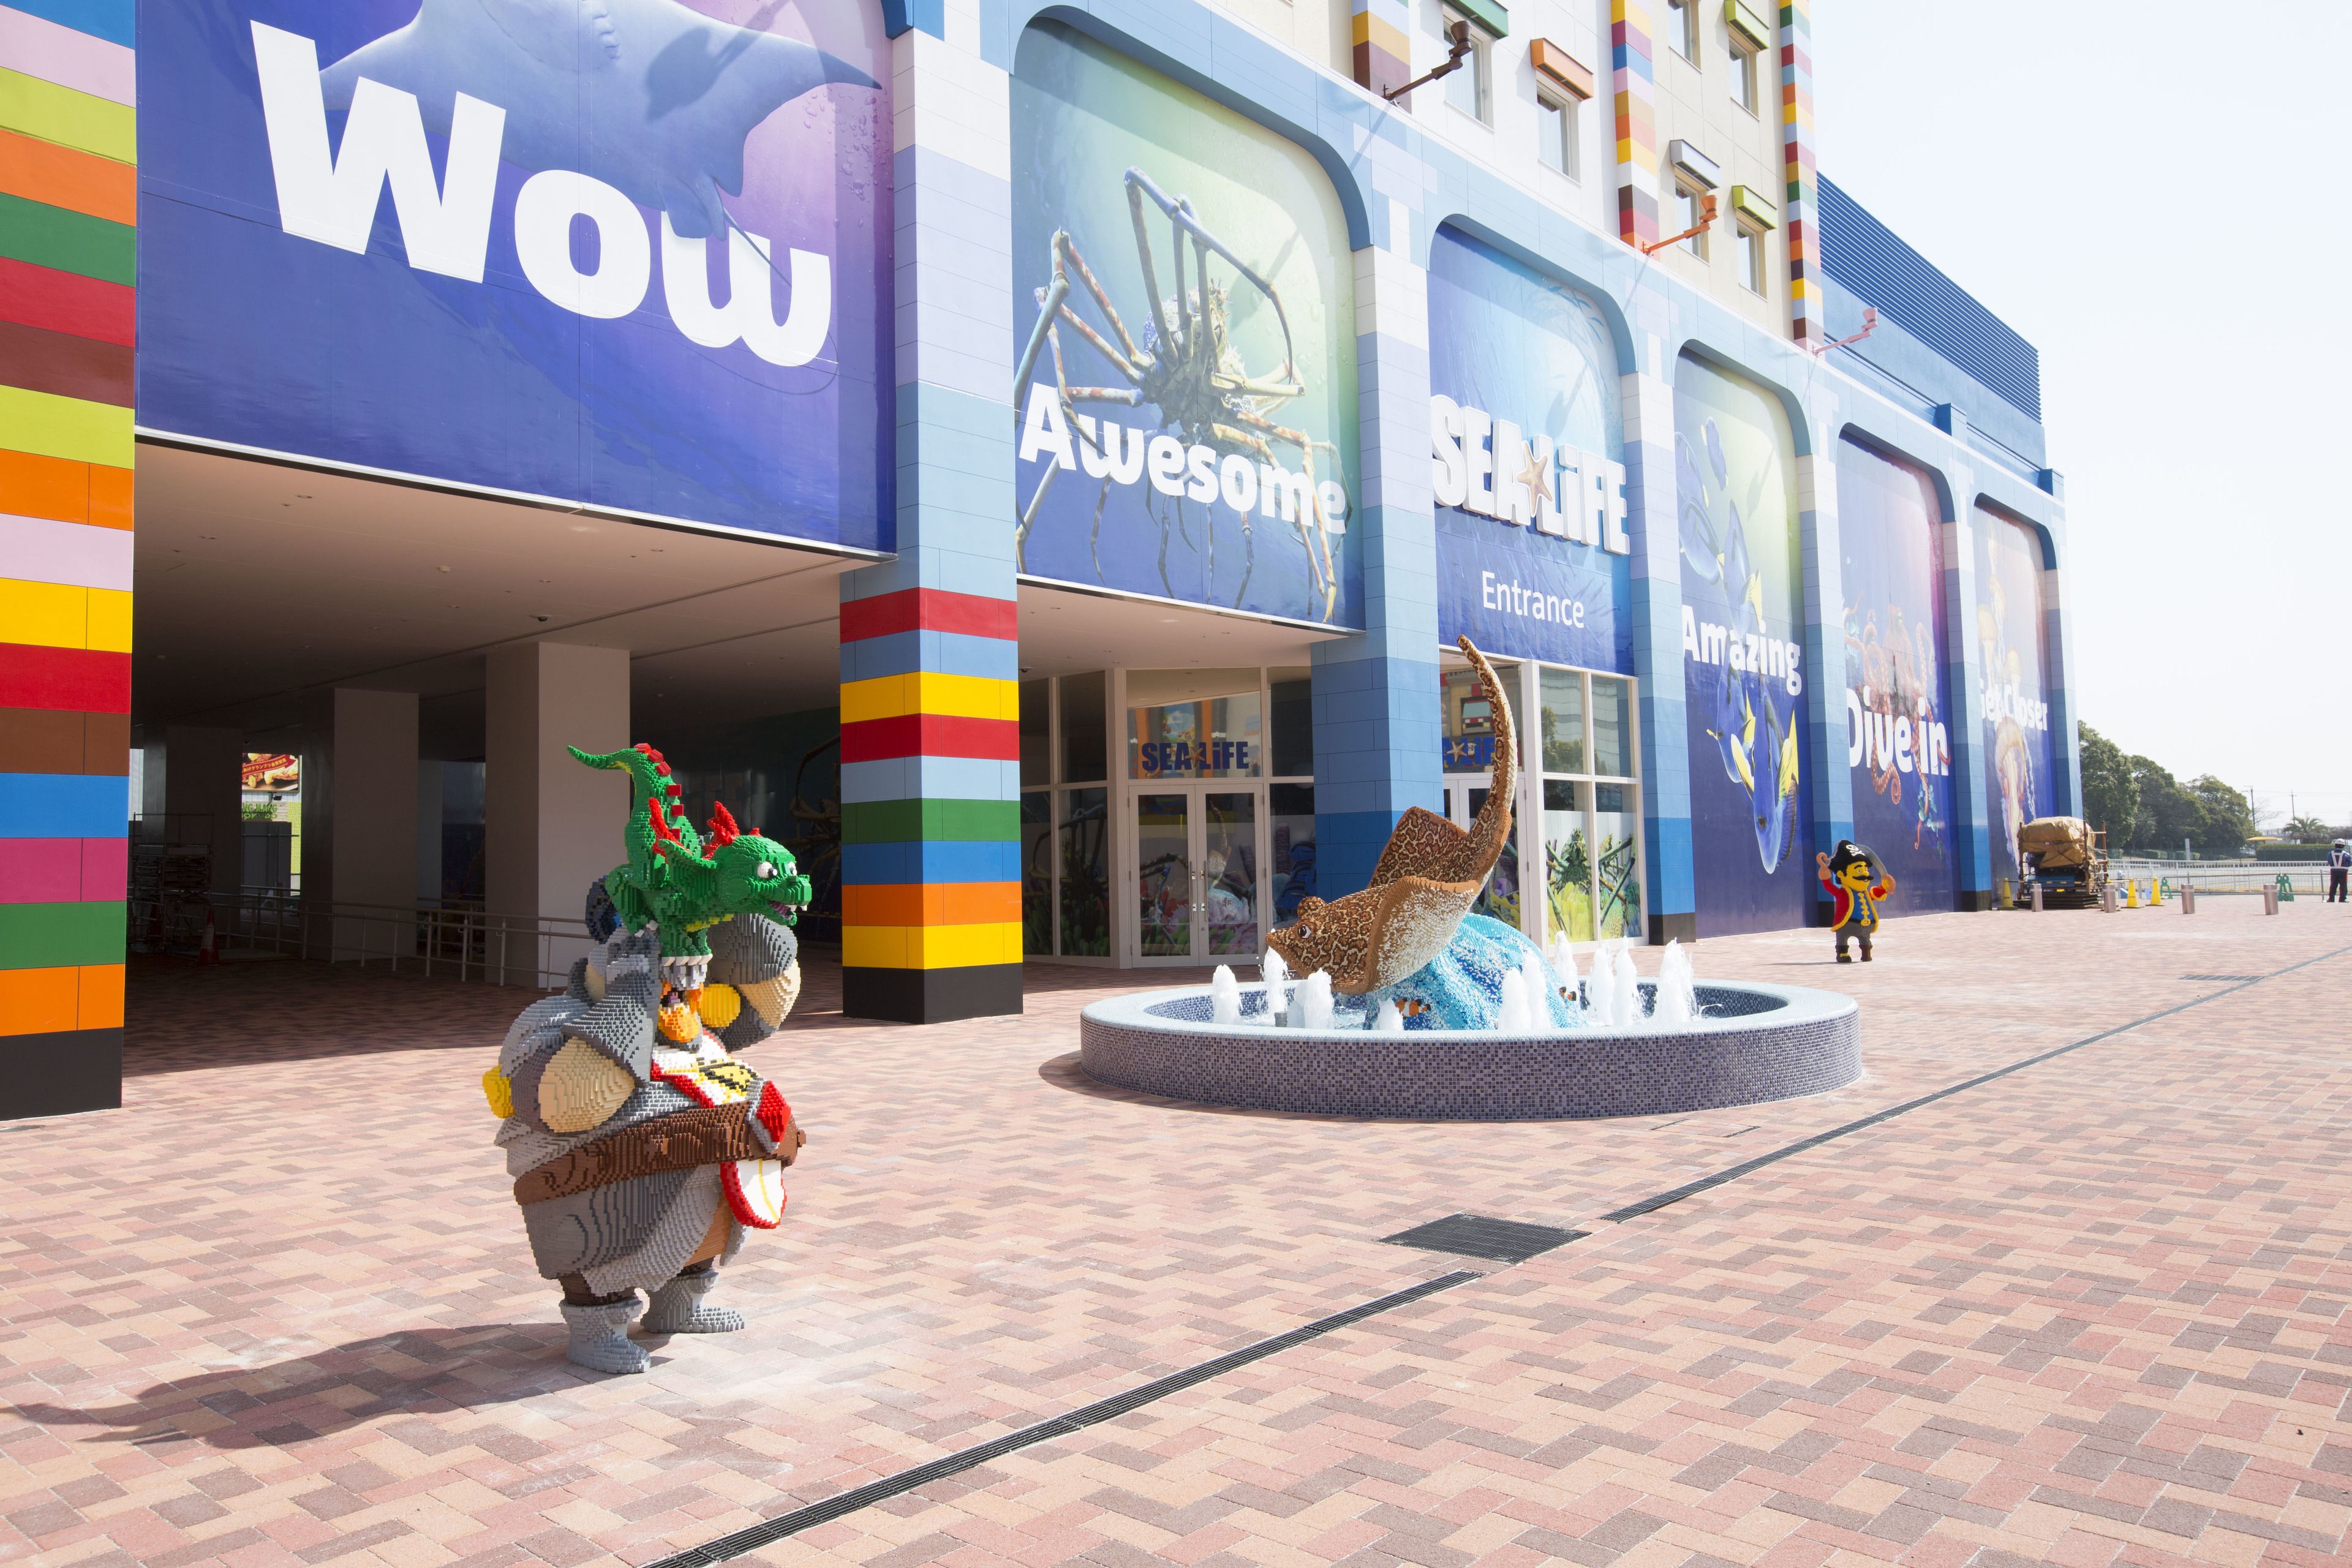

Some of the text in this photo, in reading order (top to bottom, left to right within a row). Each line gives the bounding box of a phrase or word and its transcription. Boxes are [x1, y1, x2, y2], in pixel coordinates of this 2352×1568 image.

[250, 20, 831, 367] Wow
[1019, 382, 1346, 533] Awesome
[1430, 394, 1531, 526] SEA
[1482, 571, 1584, 628] Entrance
[1682, 605, 1801, 696] Amazing
[1142, 742, 1192, 771] SEA
[1846, 685, 1948, 775] Dive in
